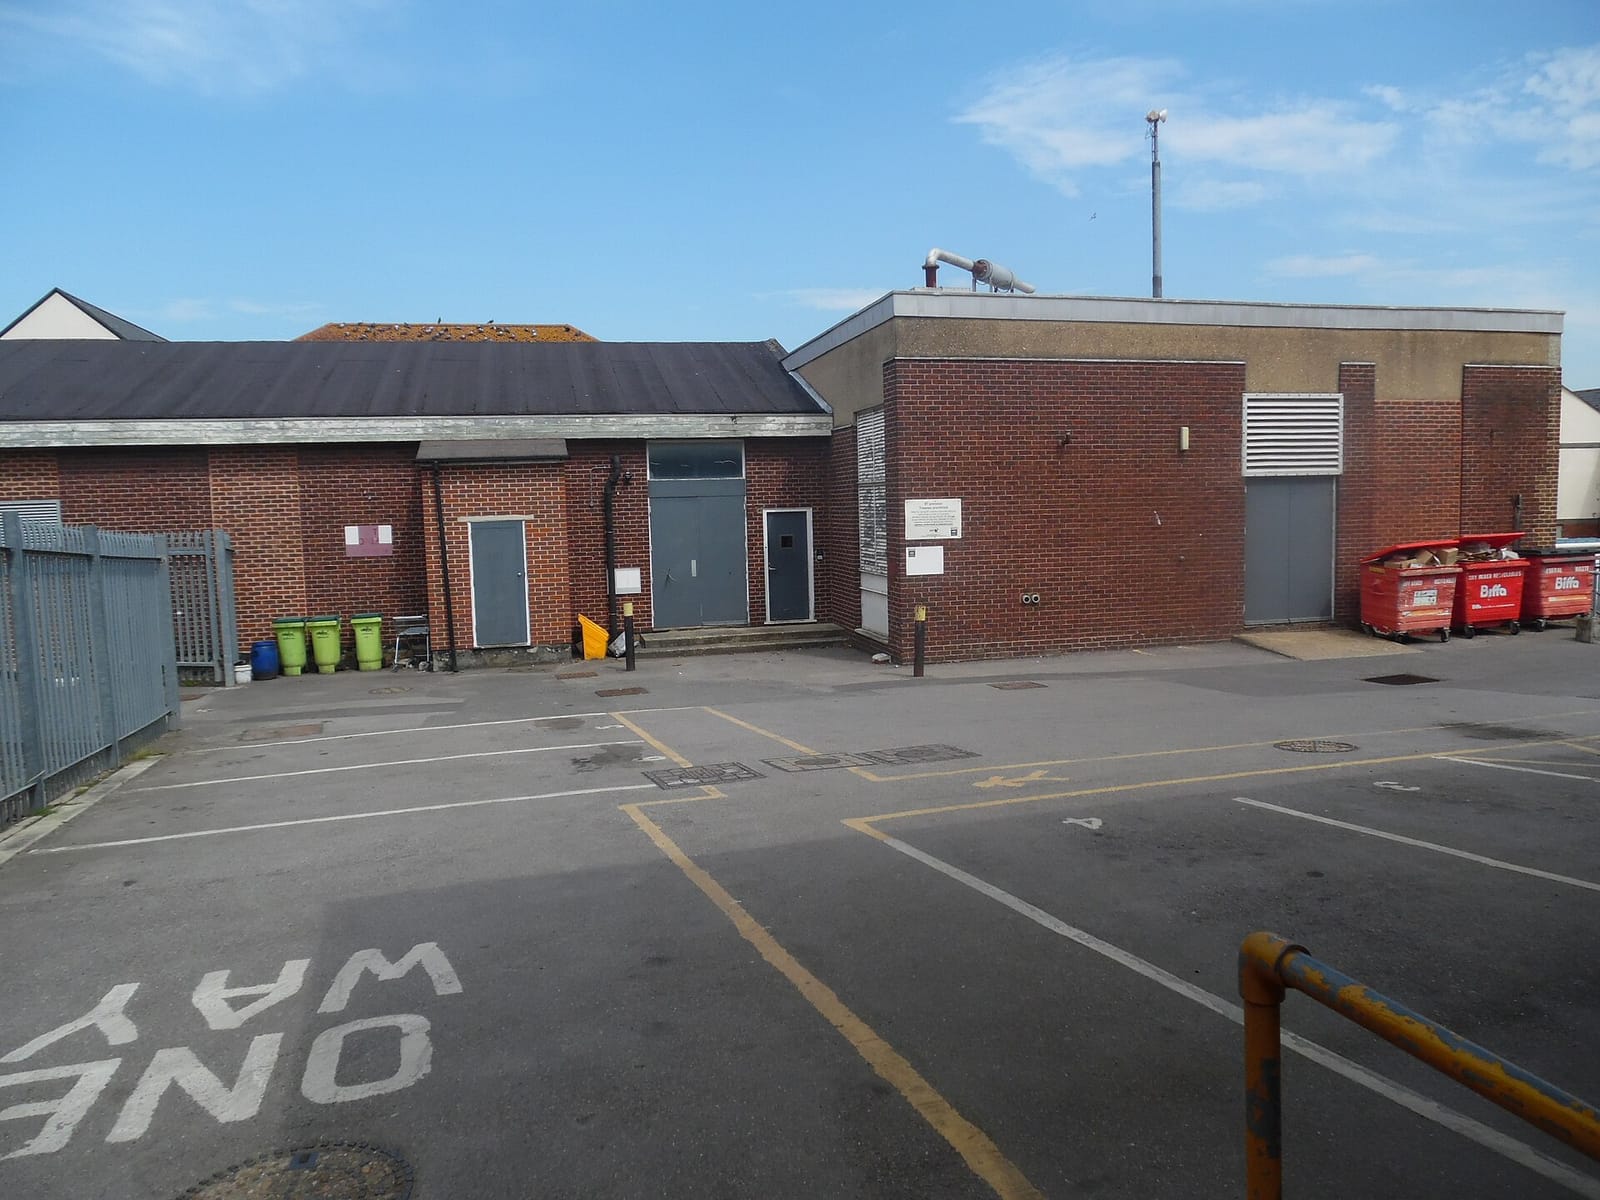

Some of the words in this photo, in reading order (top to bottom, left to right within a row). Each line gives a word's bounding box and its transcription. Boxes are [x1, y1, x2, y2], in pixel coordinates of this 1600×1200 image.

[1480, 584, 1508, 598] Biffa
[1554, 576, 1580, 590] Biffa
[0, 942, 463, 1063] WAY
[0, 1014, 433, 1160] ONE
